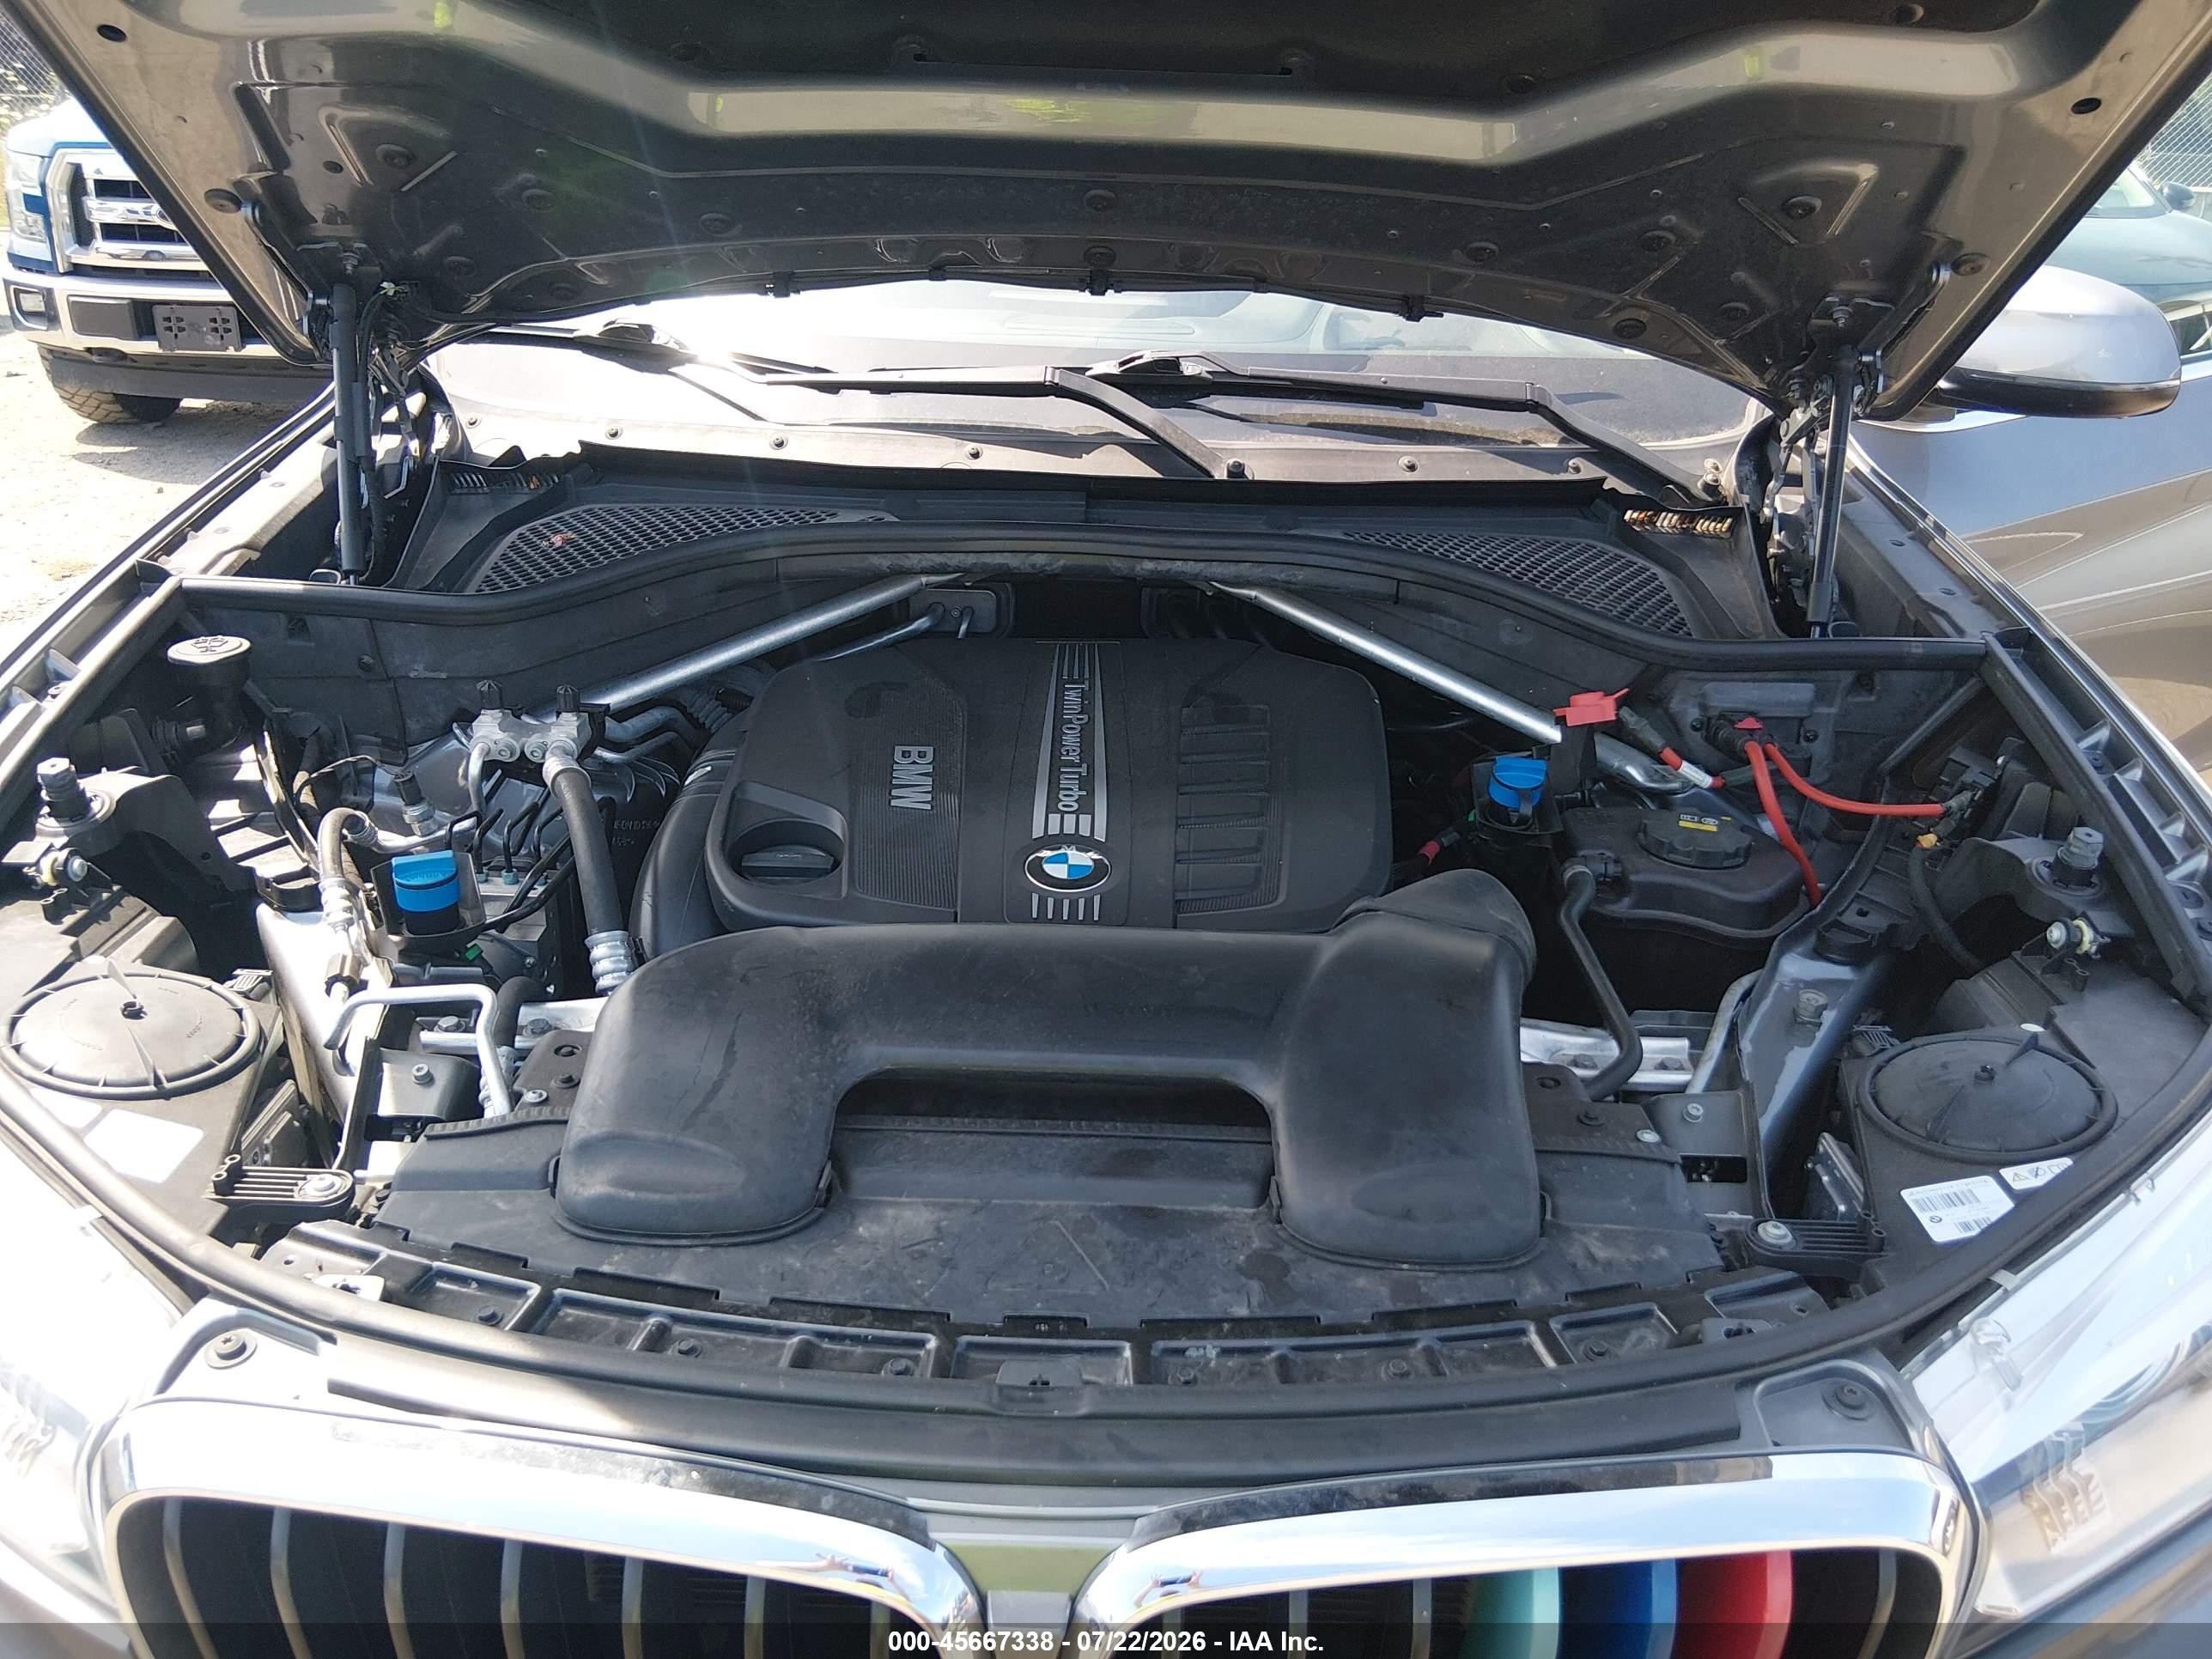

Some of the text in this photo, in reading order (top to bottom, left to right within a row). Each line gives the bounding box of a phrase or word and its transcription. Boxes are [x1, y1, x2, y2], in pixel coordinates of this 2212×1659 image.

[1060, 678, 1089, 763] TwinPower
[890, 745, 934, 810] BMW
[1057, 763, 1088, 811] Turbo
